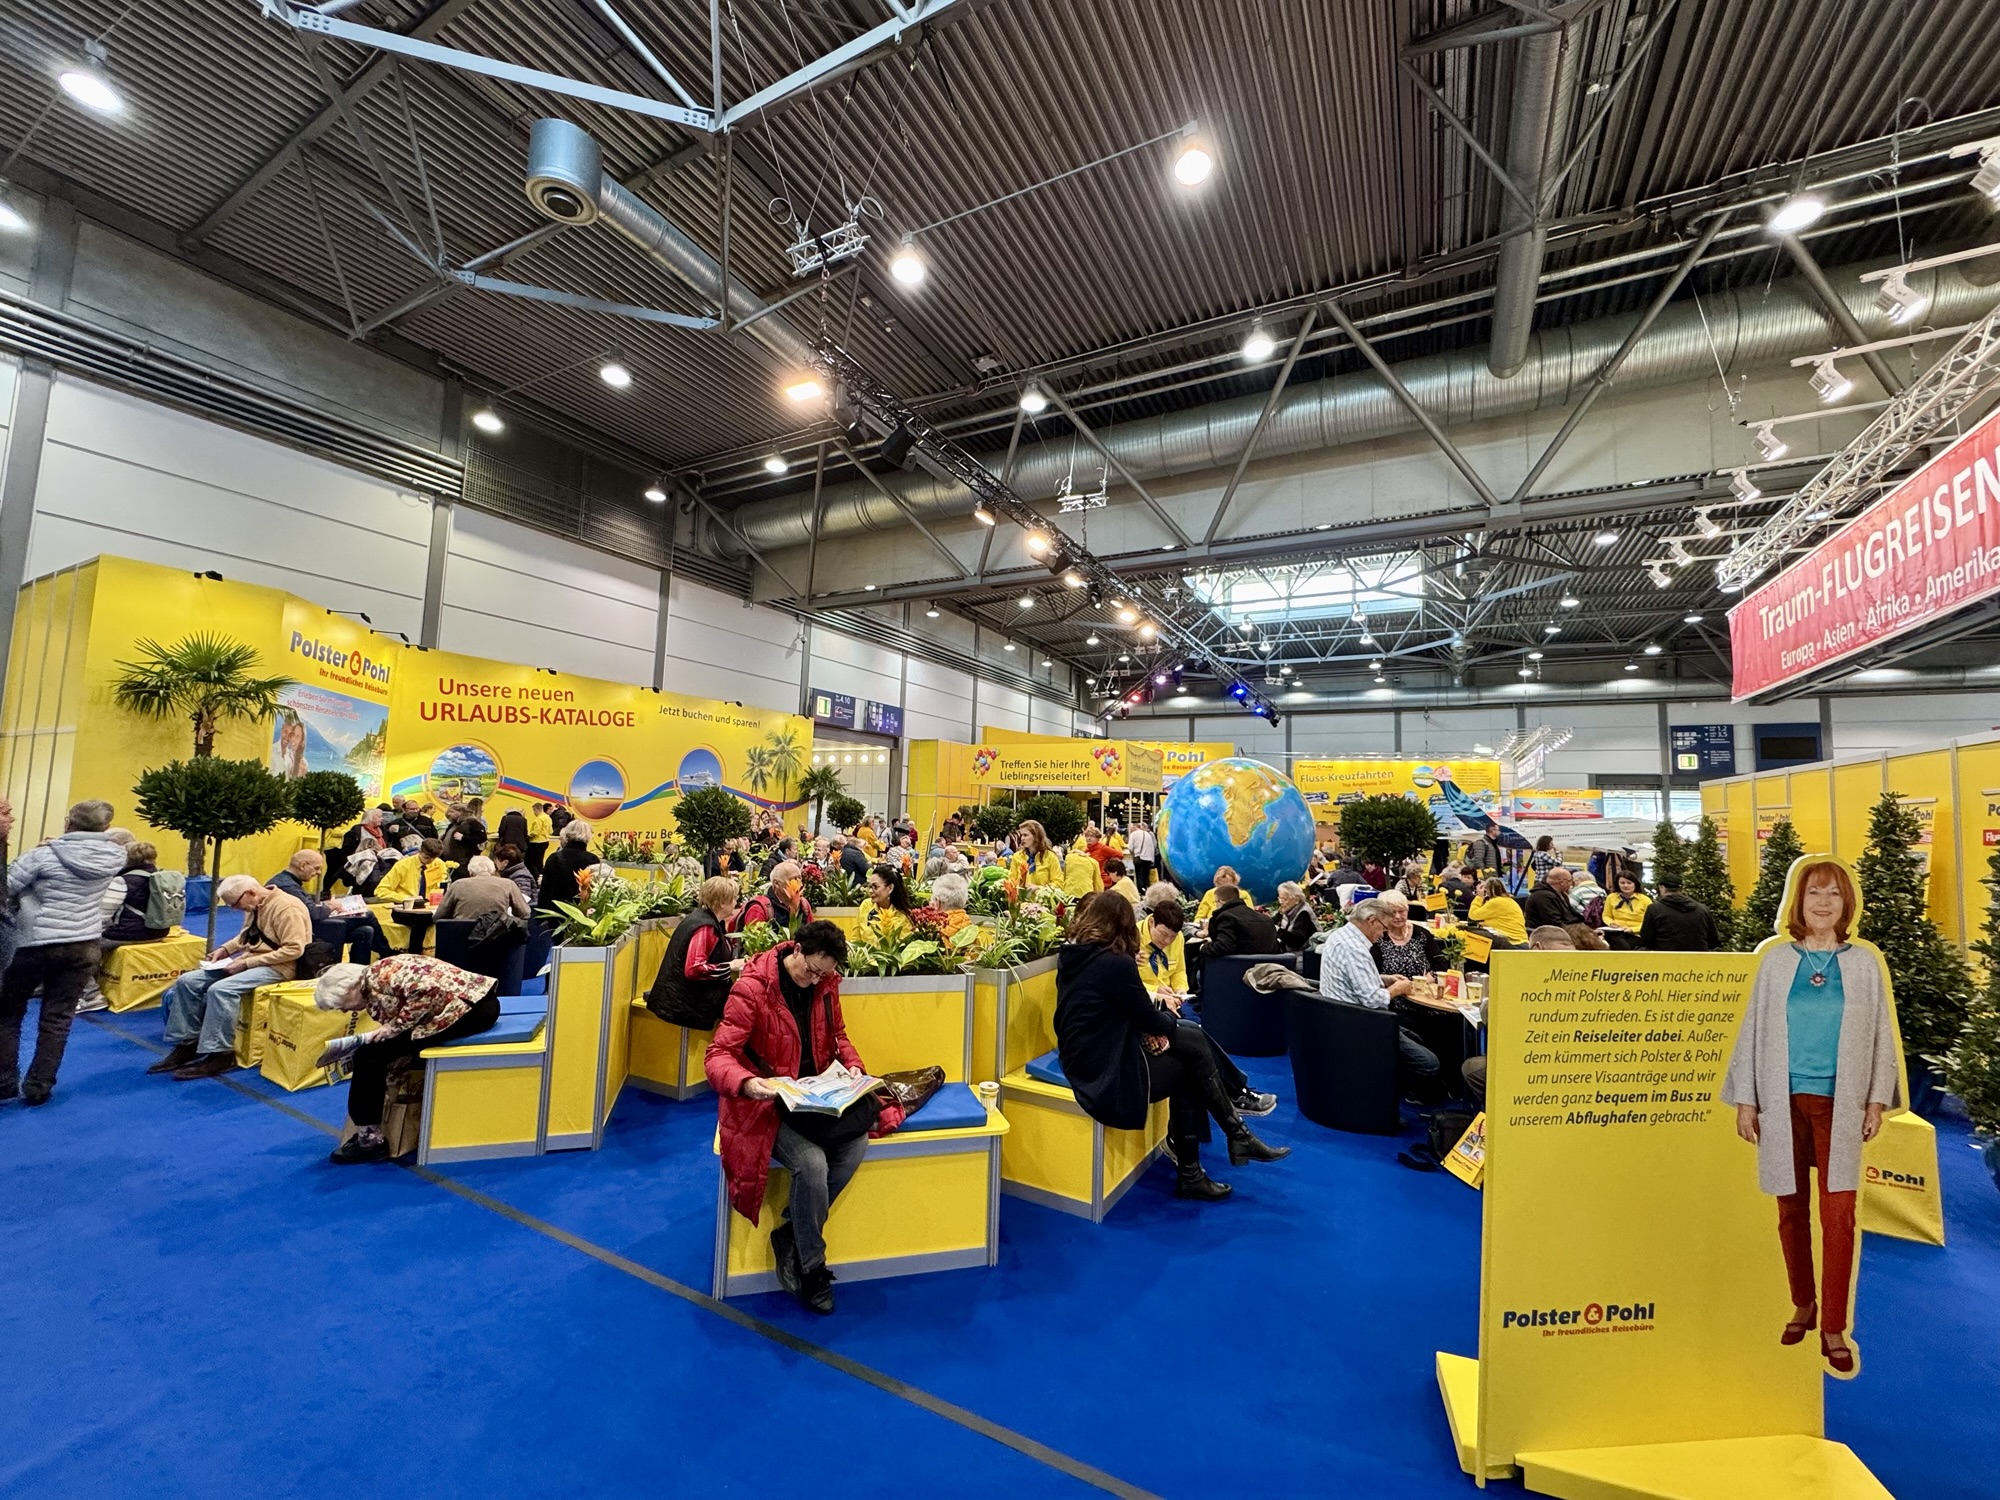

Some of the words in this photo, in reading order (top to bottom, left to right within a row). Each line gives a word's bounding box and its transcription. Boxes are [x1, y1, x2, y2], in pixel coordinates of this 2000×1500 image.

[1759, 445, 2000, 640] Traum-FLUGREISEN
[1781, 642, 1814, 670] Europa
[1823, 622, 1855, 650] Asien
[1866, 594, 1910, 630] Afrika
[1925, 546, 2000, 603] Amerika
[290, 630, 348, 669] Polster
[351, 652, 361, 673] &
[362, 657, 390, 684] Pohl
[319, 668, 329, 677] Ihr
[330, 671, 364, 688] freundliches
[439, 677, 512, 698] Unsere
[518, 686, 574, 702] neuen
[420, 701, 635, 727] URLAUBS-KATALOGE
[658, 705, 680, 717] Jetzt
[682, 708, 713, 721] buchen
[715, 716, 731, 724] und
[732, 718, 761, 729] sparen!
[1167, 751, 1204, 762] Pohl
[1000, 760, 1032, 769] Treffen
[1034, 760, 1047, 769] Sie
[1050, 760, 1069, 769] hier
[1071, 760, 1090, 769] Ihre
[1000, 771, 1090, 782] Lieblingsreiseleiter!
[1300, 771, 1394, 783] Fluss-Kreuzfahrten
[645, 831, 657, 839] zu
[131, 972, 169, 981] Polster
[1544, 970, 1588, 983] „Meine
[1591, 969, 1658, 984] Flugreisen
[1662, 970, 1703, 982] mache
[1706, 971, 1723, 982] ich
[1726, 973, 1748, 982] nur
[1521, 990, 1551, 1002] noch
[1555, 990, 1575, 1002] mit
[1579, 990, 1619, 1002] Polster
[1622, 990, 1632, 1002] &
[1634, 990, 1664, 1002] Pohl.
[1667, 990, 1692, 1002] Hier
[1694, 990, 1719, 1002] sind
[1722, 991, 1741, 1002] wir
[348, 1011, 359, 1036] olste
[1529, 1010, 1578, 1022] rundum
[1581, 1010, 1641, 1025] zufrieden.
[1645, 1010, 1657, 1022] Es
[1660, 1010, 1673, 1022] ist
[1676, 1010, 1694, 1022] die
[1697, 1012, 1734, 1025] ganze
[1525, 1030, 1549, 1043] Zeit
[1552, 1031, 1570, 1042] ein
[1573, 1030, 1642, 1043] Reiseleiter
[1645, 1030, 1684, 1042] dabei.
[1687, 1029, 1727, 1042] Außer-
[1524, 1051, 1550, 1063] dem
[1554, 1050, 1611, 1063] kümmert
[1613, 1050, 1637, 1063] sich
[1640, 1050, 1679, 1062] Polster
[1683, 1050, 1692, 1062] &
[1695, 1050, 1722, 1062] Pohl
[1528, 1074, 1548, 1084] um
[1551, 1072, 1591, 1084] unsere
[1595, 1070, 1668, 1085] Visaanträge
[1670, 1070, 1693, 1082] und
[1697, 1070, 1715, 1082] wir
[1513, 1092, 1559, 1105] werden
[1562, 1094, 1592, 1107] ganz
[1595, 1090, 1647, 1106] bequem
[1651, 1090, 1667, 1103] im
[1670, 1090, 1693, 1102] Bus
[1696, 1092, 1711, 1102] zu
[1510, 1114, 1562, 1126] unserem
[1566, 1110, 1646, 1127] Abflughafen
[1650, 1110, 1711, 1126] gebracht.“
[1882, 1169, 1925, 1186] Pohl
[1503, 1309, 1581, 1328] Polster
[1585, 1304, 1602, 1324] &
[1606, 1303, 1655, 1322] Pohl
[1542, 1329, 1555, 1337] Ihr
[1558, 1325, 1610, 1336] freundliches
[1612, 1323, 1654, 1333] Reisebüro
